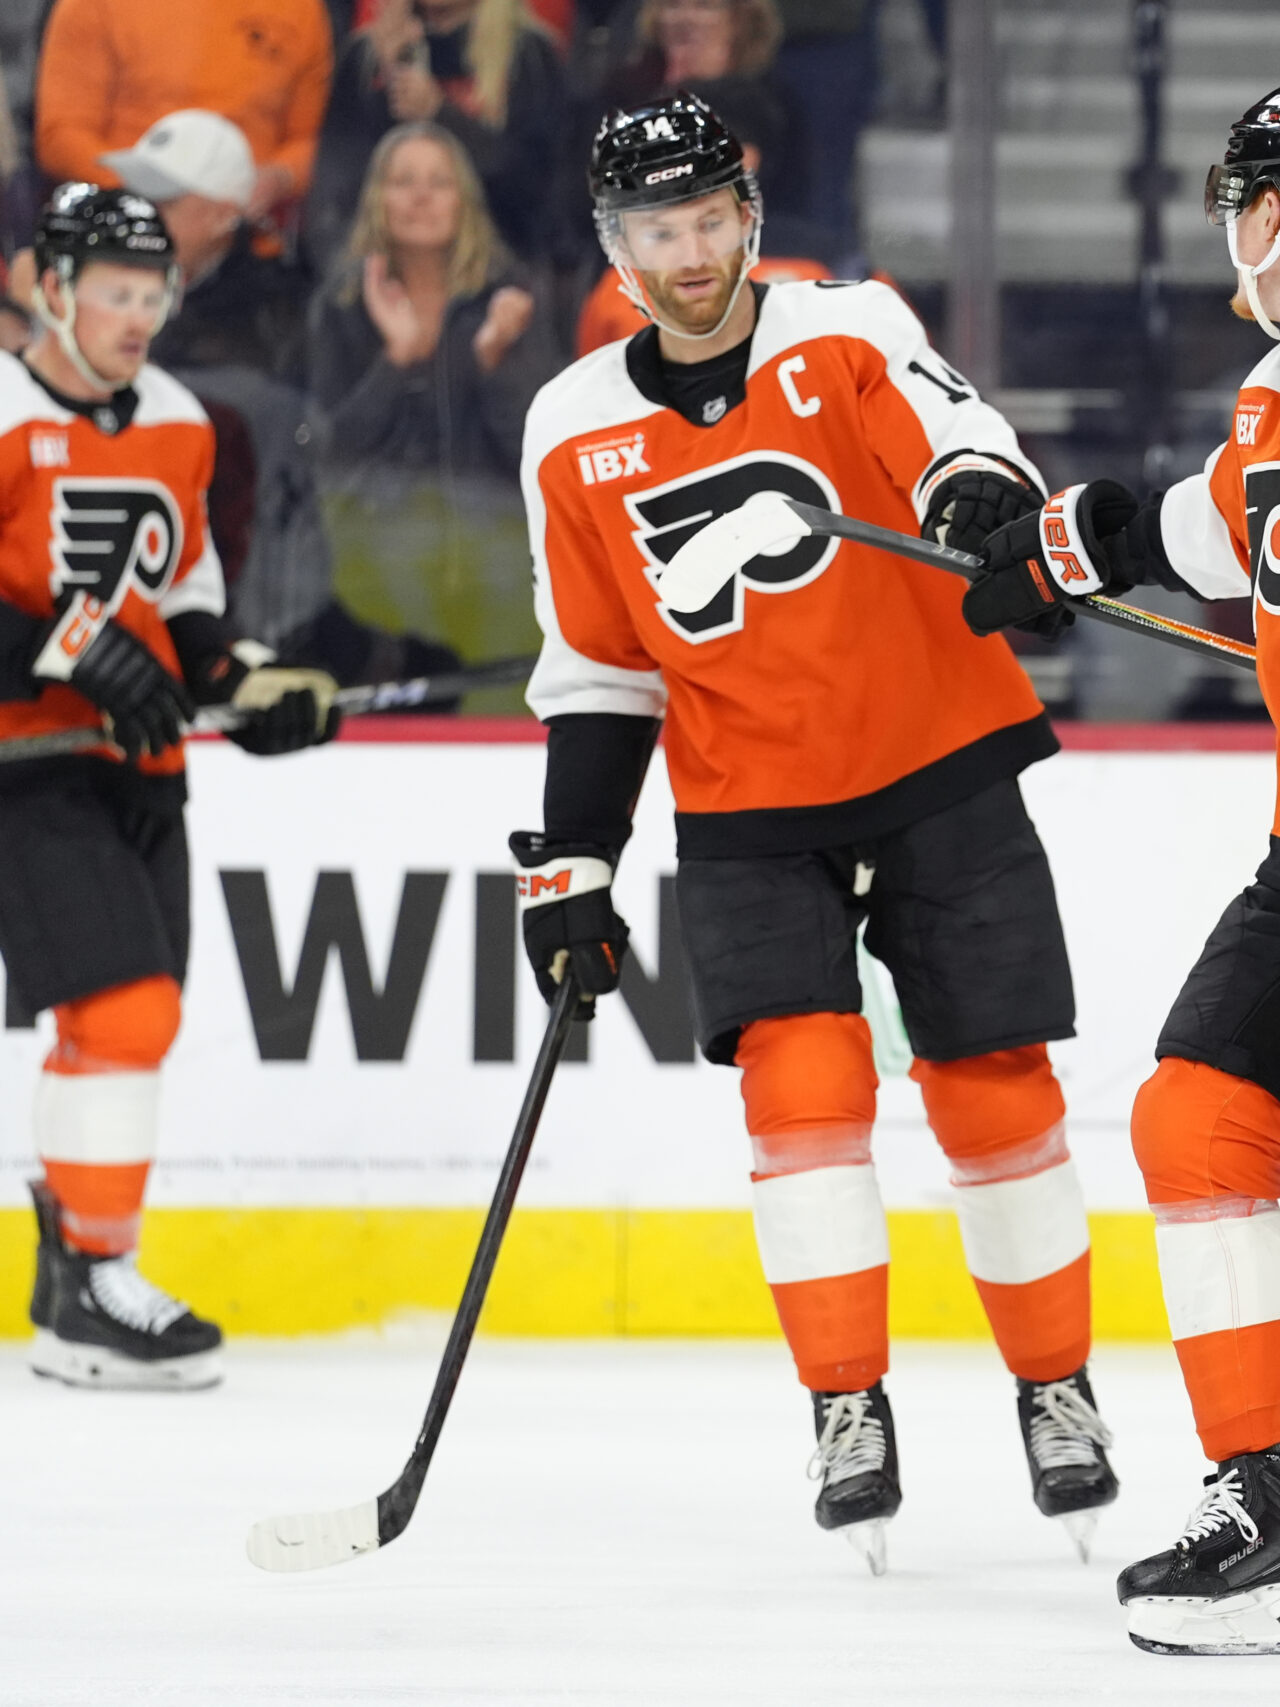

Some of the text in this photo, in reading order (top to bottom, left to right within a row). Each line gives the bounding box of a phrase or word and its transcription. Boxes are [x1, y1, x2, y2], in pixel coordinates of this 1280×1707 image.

[642, 116, 674, 140] 14
[645, 163, 693, 185] CCM
[777, 354, 822, 418] C
[578, 442, 651, 485] IBX
